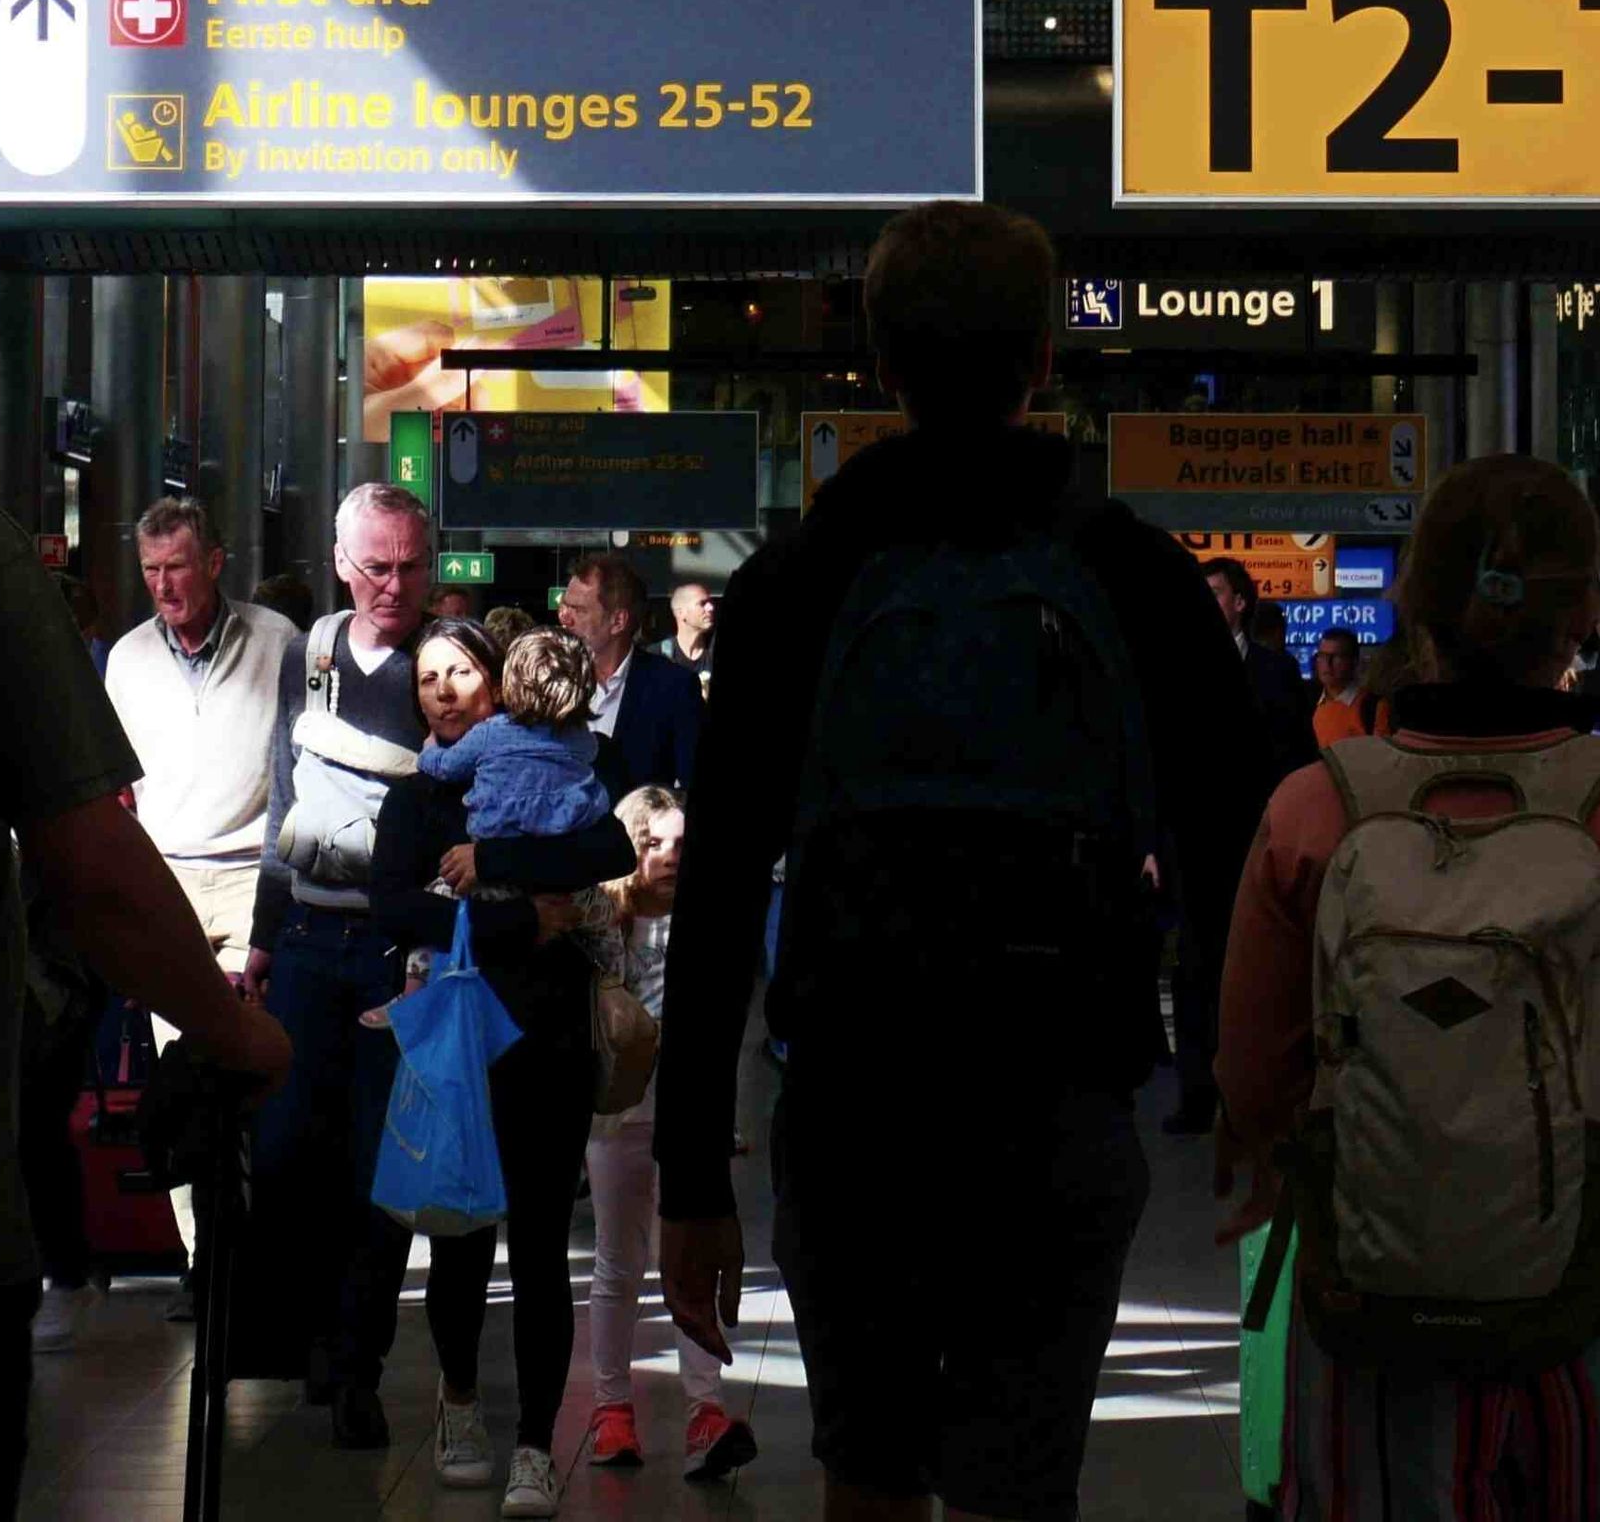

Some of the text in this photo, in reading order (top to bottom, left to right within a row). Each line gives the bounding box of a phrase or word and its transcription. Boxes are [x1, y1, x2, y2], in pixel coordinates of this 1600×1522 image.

[205, 17, 406, 56] Eerste hulp
[203, 80, 813, 141] Airline lounges 25-52
[204, 138, 519, 178] By invitation only
[1138, 279, 1334, 332] Lounge 1
[1169, 422, 1353, 451] Baggage hall
[1176, 460, 1352, 485] Arrivals Exit
[648, 534, 674, 547] Baby
[1255, 536, 1284, 546] Gates
[1331, 604, 1376, 625] FOR
